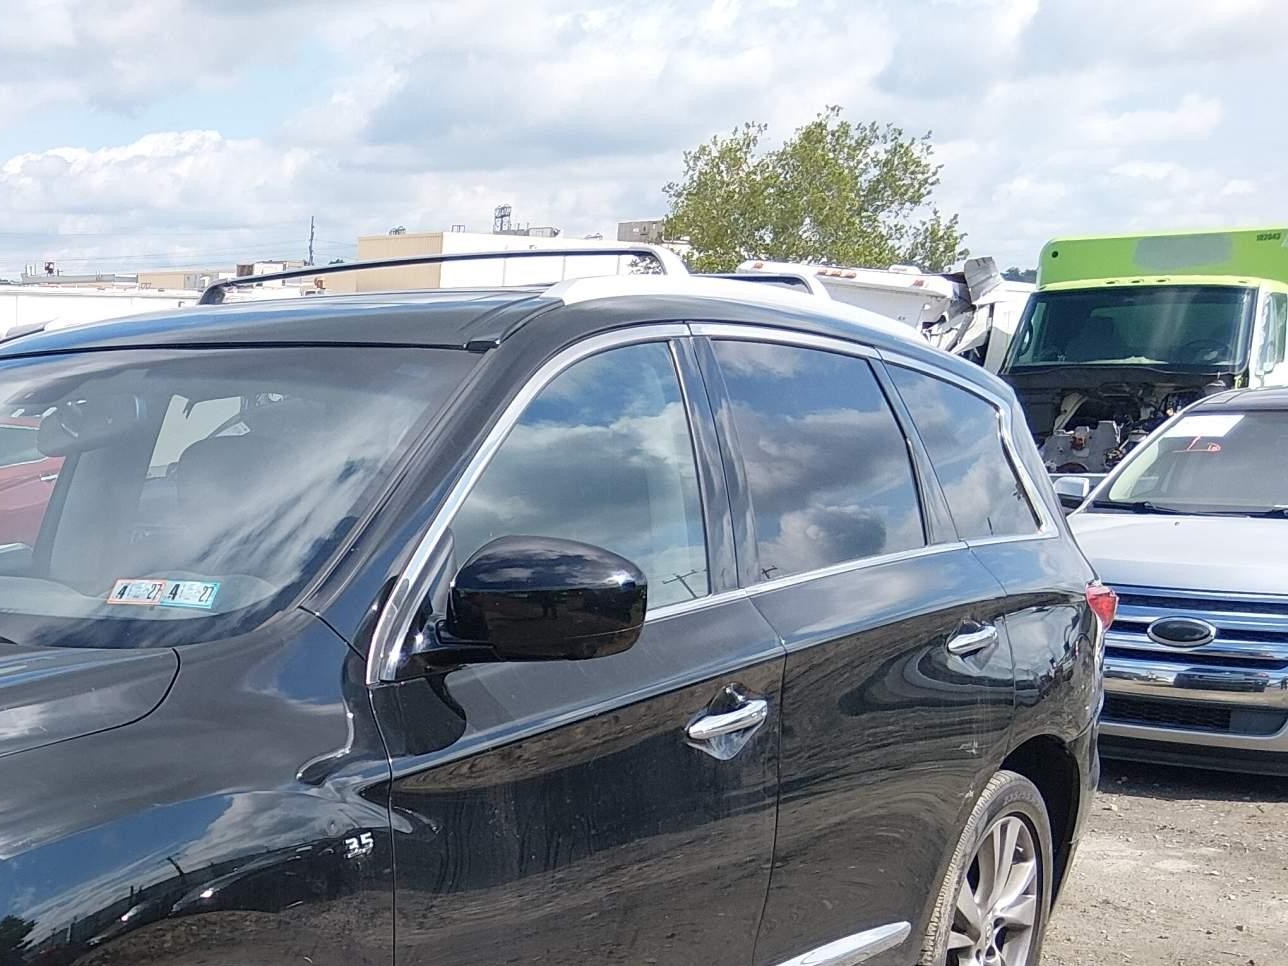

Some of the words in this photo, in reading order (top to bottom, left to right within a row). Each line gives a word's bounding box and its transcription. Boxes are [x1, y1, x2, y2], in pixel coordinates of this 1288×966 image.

[116, 585, 128, 600] 4
[146, 583, 163, 601] 27
[168, 583, 181, 600] 4
[198, 585, 215, 603] 27
